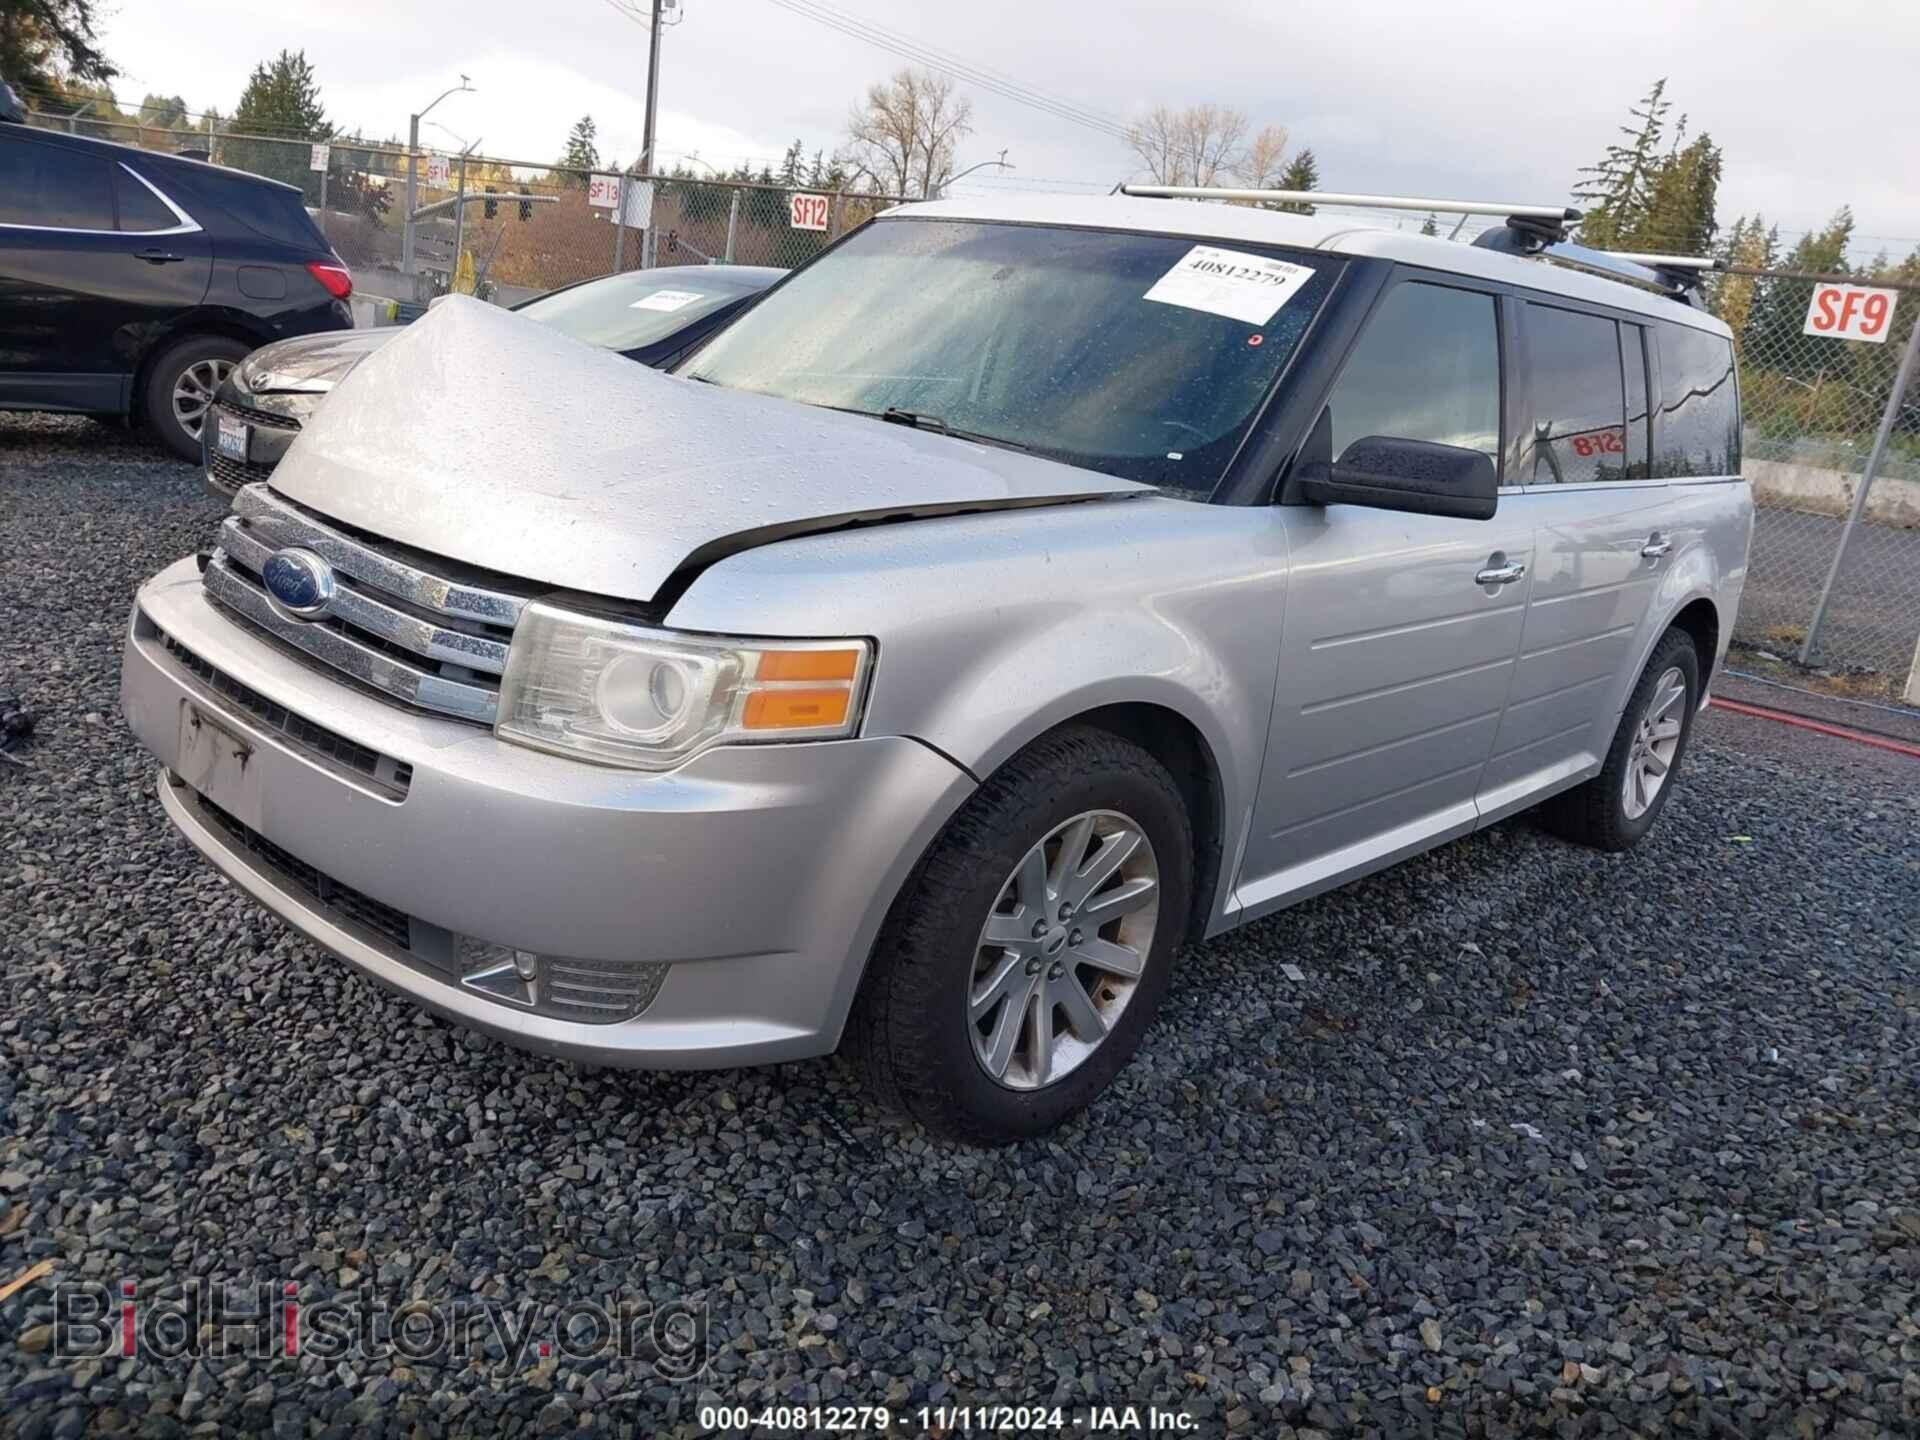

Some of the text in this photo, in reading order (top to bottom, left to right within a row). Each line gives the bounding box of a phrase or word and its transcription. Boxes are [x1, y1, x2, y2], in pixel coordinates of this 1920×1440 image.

[591, 182, 618, 201] SF13
[793, 197, 827, 226] SF12
[1190, 259, 1287, 287] 40812279
[1812, 288, 1889, 336] SF9
